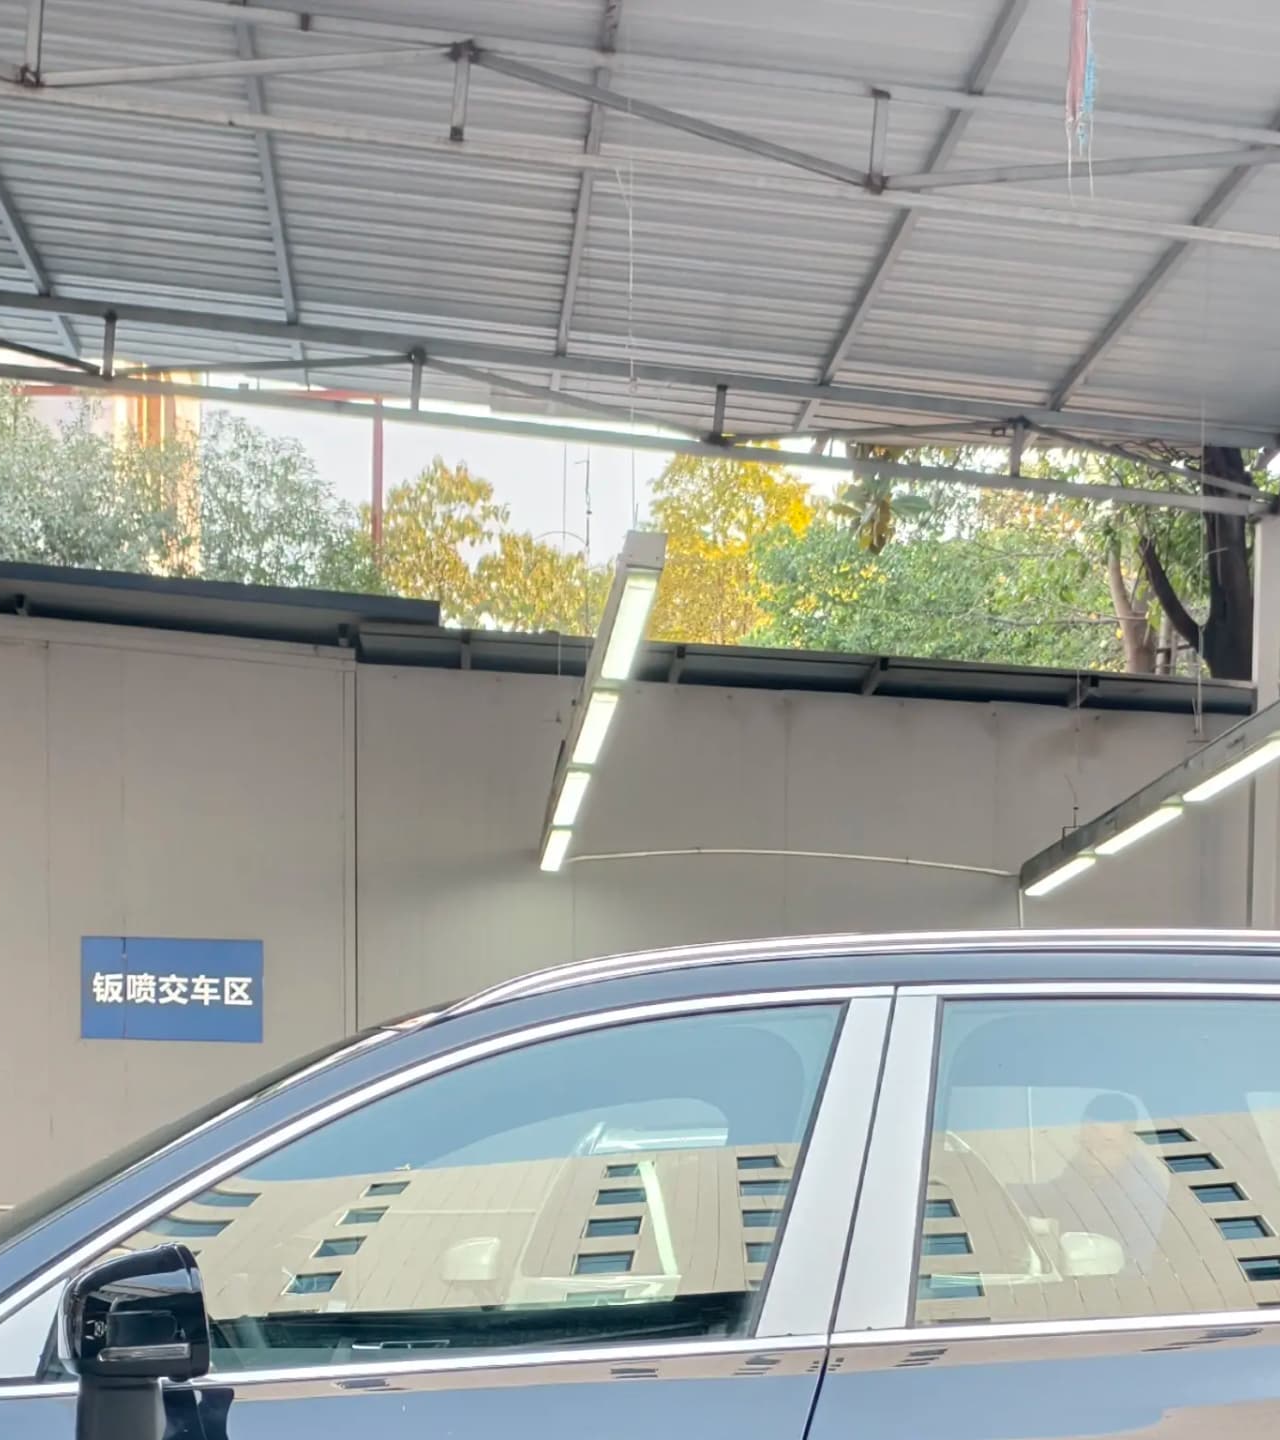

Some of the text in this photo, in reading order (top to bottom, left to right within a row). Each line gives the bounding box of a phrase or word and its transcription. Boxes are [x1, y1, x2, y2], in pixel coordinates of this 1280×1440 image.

[92, 972, 253, 1006] 钣喷交车区
